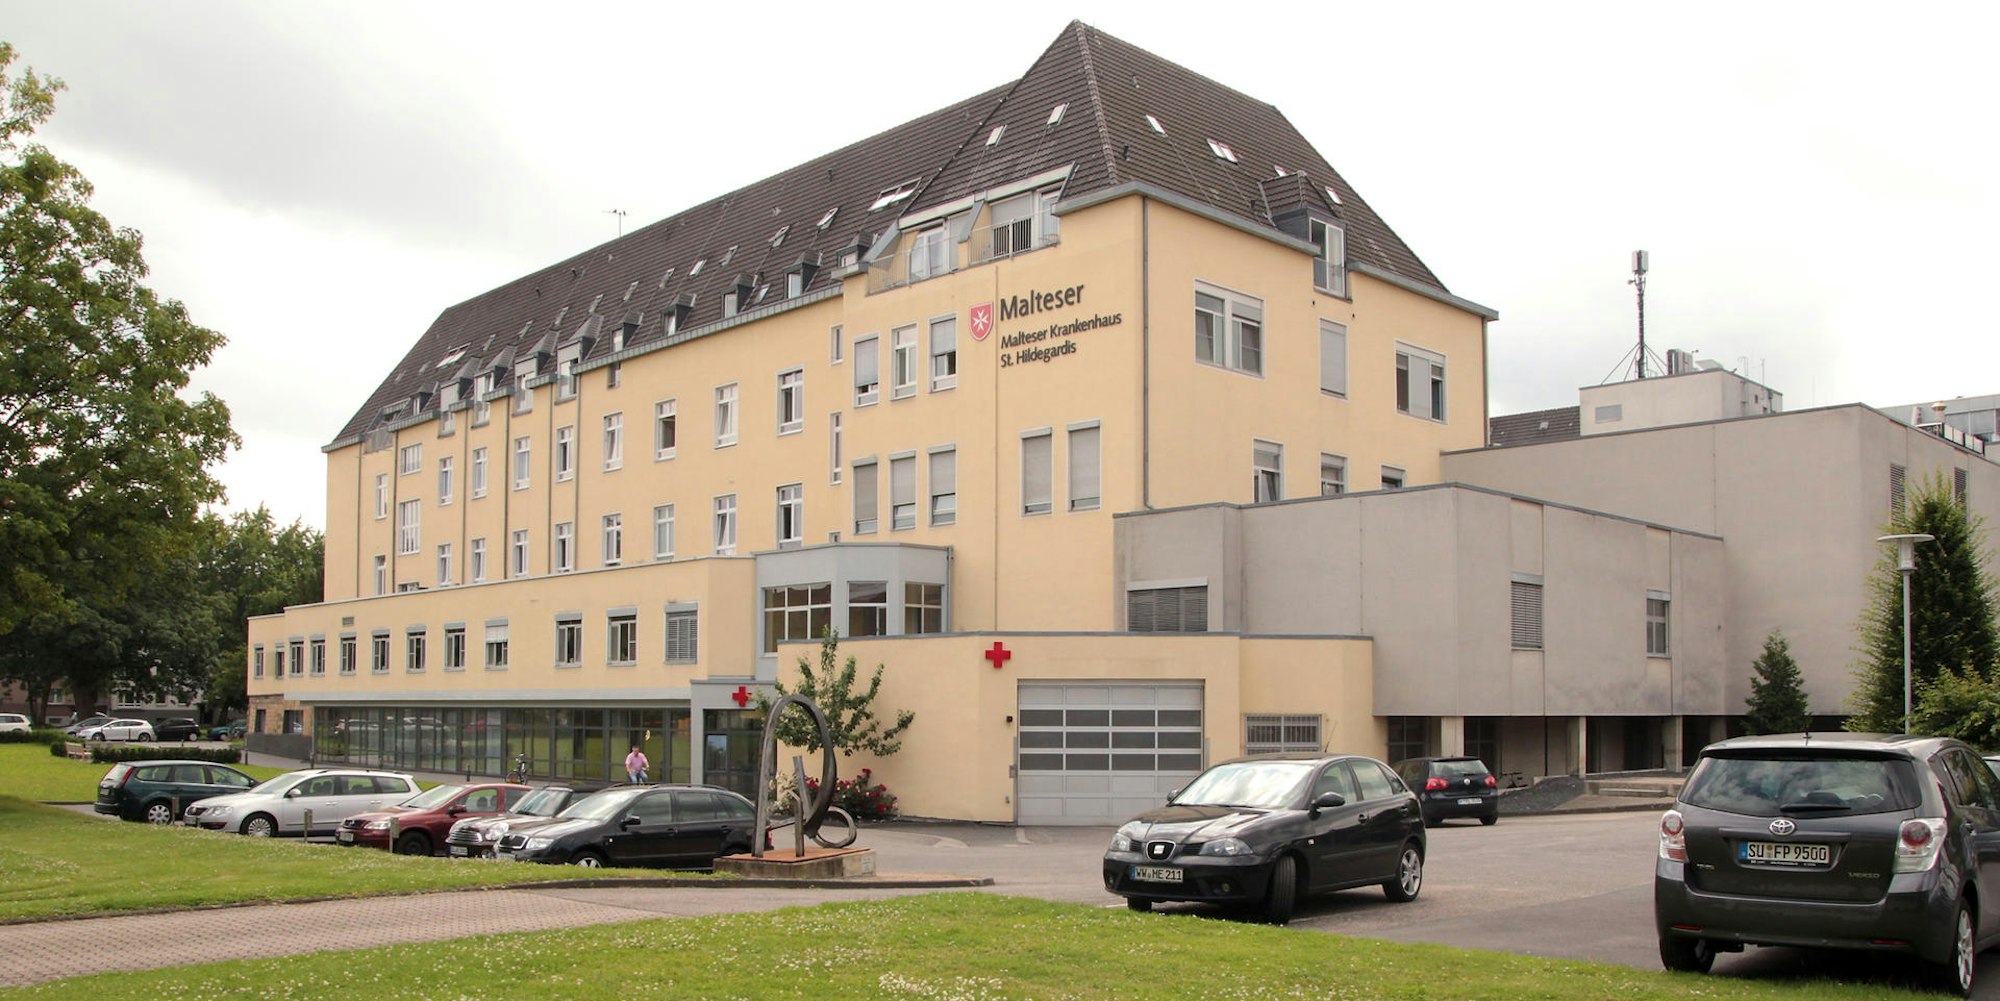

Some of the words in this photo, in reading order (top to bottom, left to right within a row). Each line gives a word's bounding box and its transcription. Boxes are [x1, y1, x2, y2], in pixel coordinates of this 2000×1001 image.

[1000, 284, 1084, 321] Malteser
[1001, 329, 1048, 349] Malteser
[1050, 313, 1122, 338] Krankenhaus
[1000, 353, 1014, 368] St.
[1016, 340, 1077, 363] Hildegardis
[1748, 844, 1764, 858] SU
[1774, 845, 1790, 859] FP
[1794, 846, 1827, 861] 9500
[1136, 868, 1147, 878] WW
[1165, 870, 1182, 881] 211
